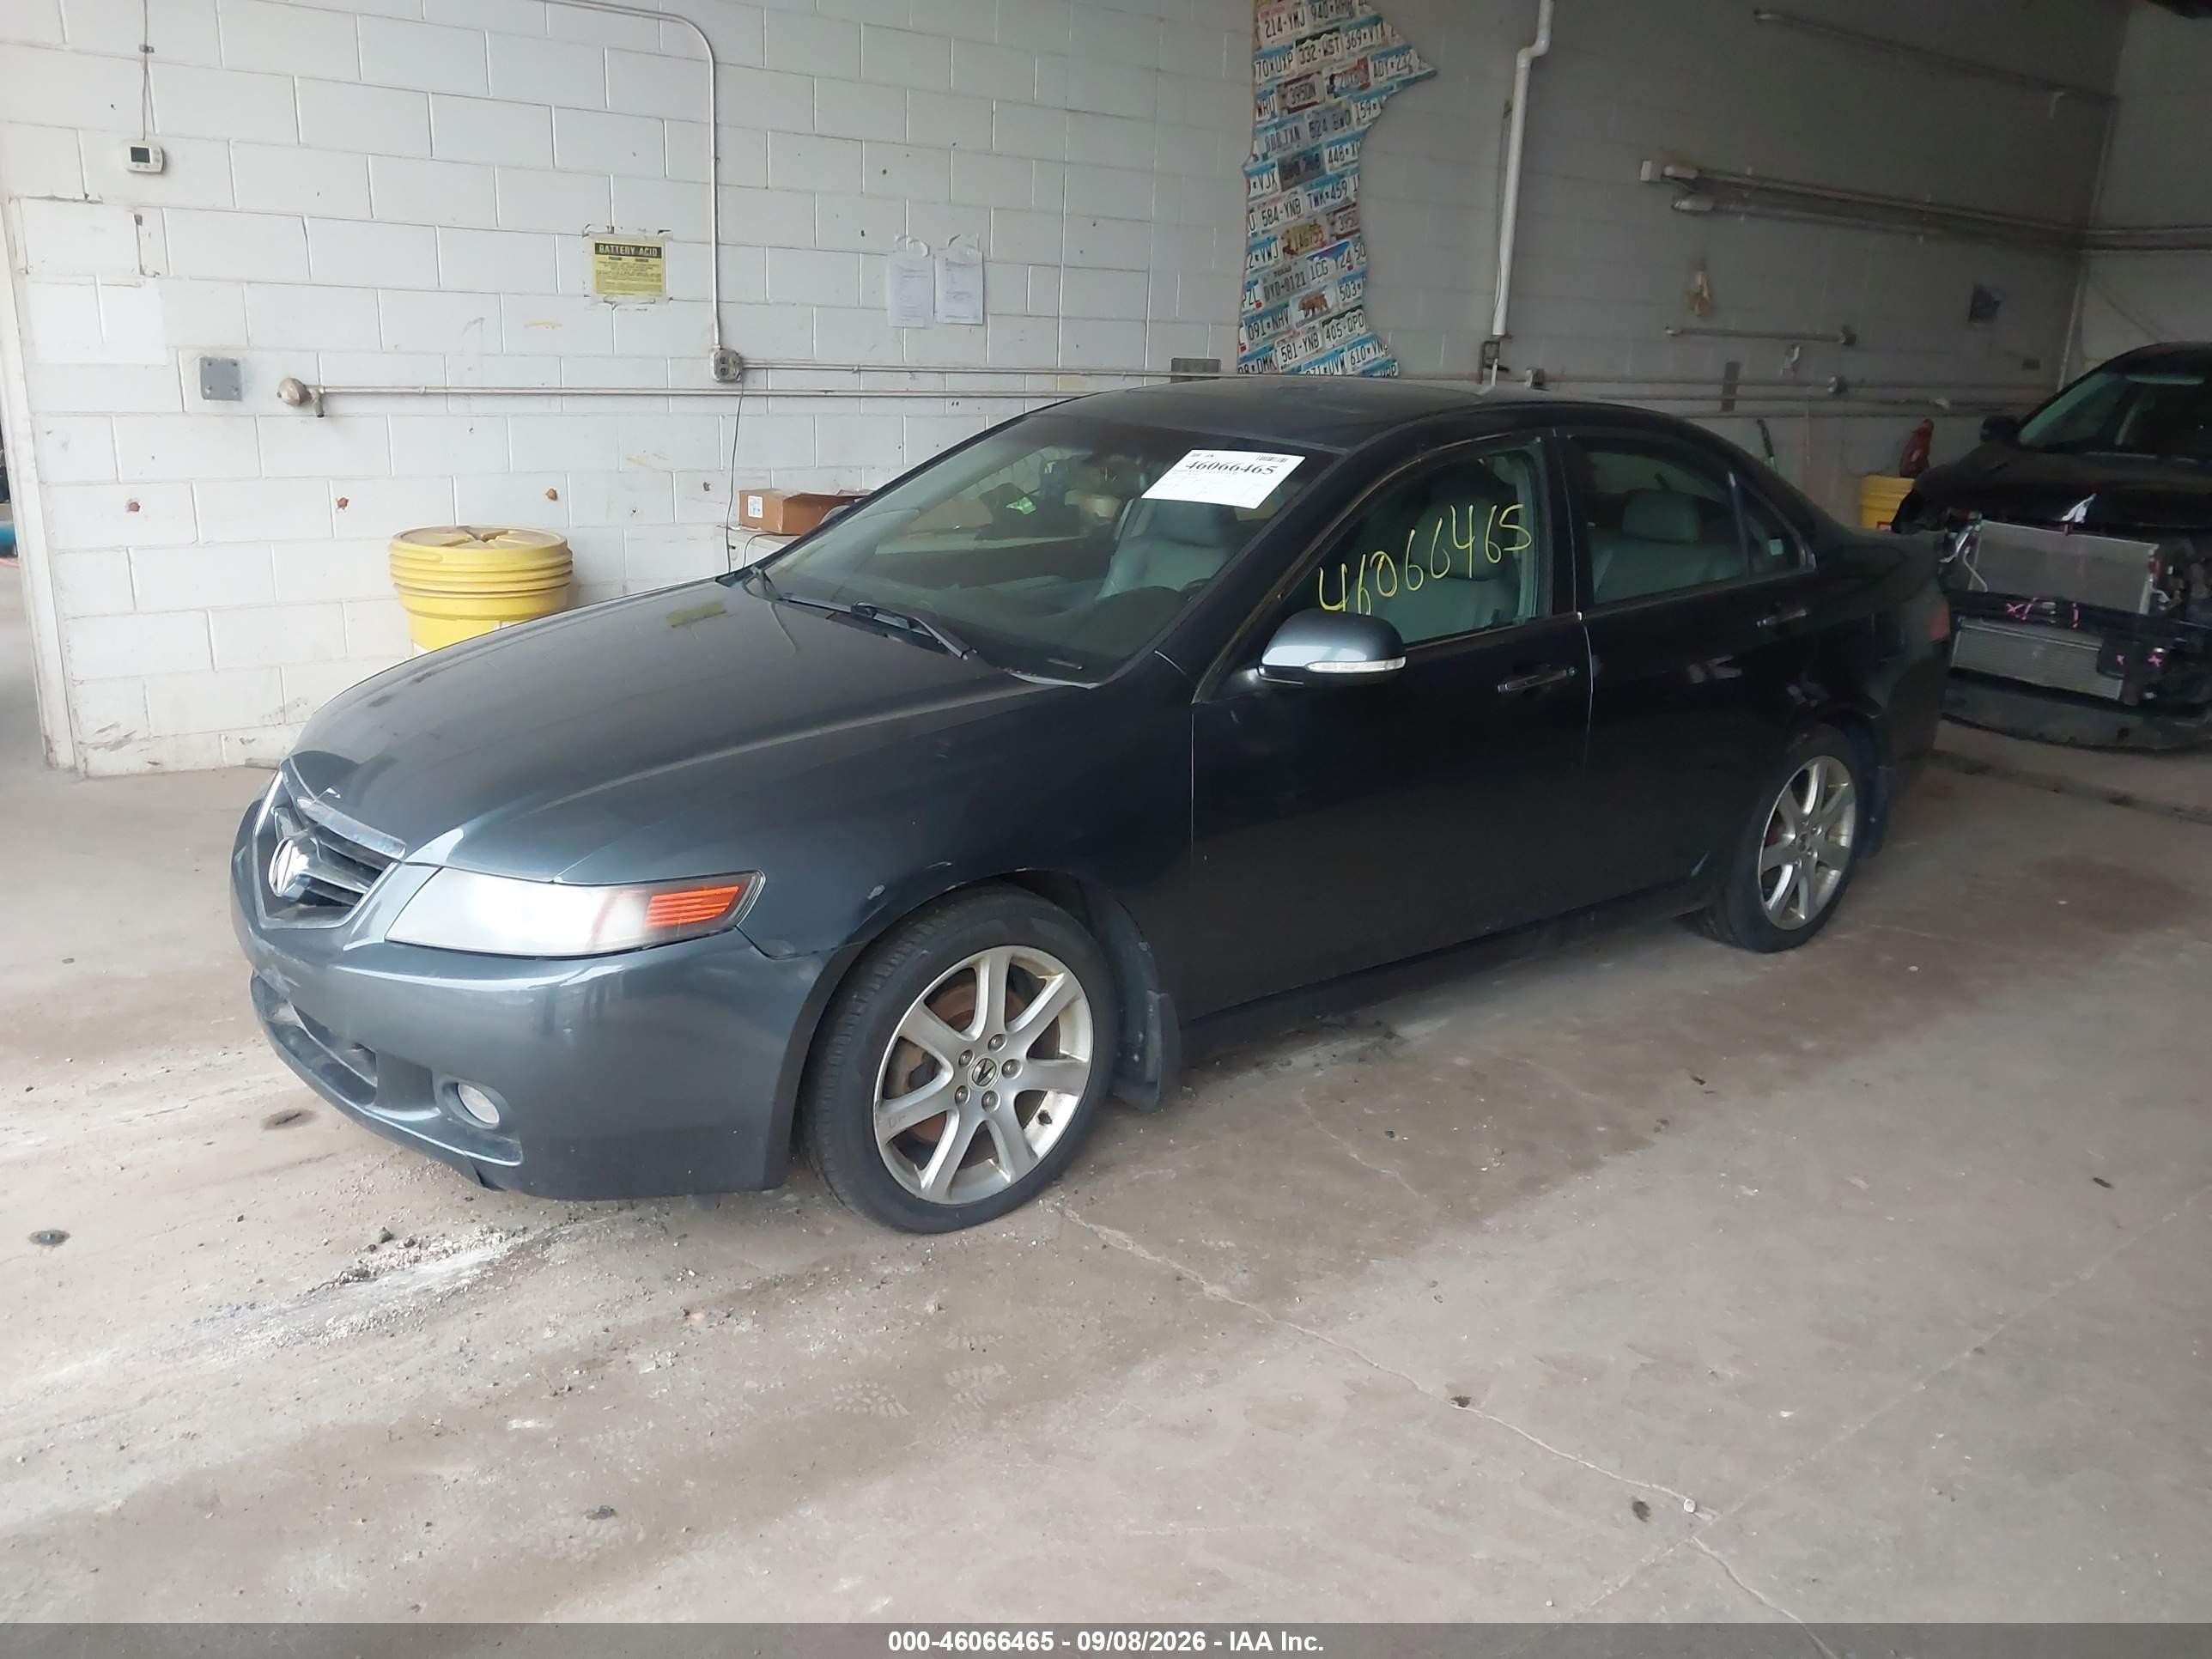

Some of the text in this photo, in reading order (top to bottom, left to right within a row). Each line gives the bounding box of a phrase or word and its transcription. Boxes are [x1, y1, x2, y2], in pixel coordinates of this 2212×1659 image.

[599, 245, 658, 257] BATTERY ACID
[1185, 461, 1278, 475] 46066465
[1319, 504, 1533, 614] 46066465
